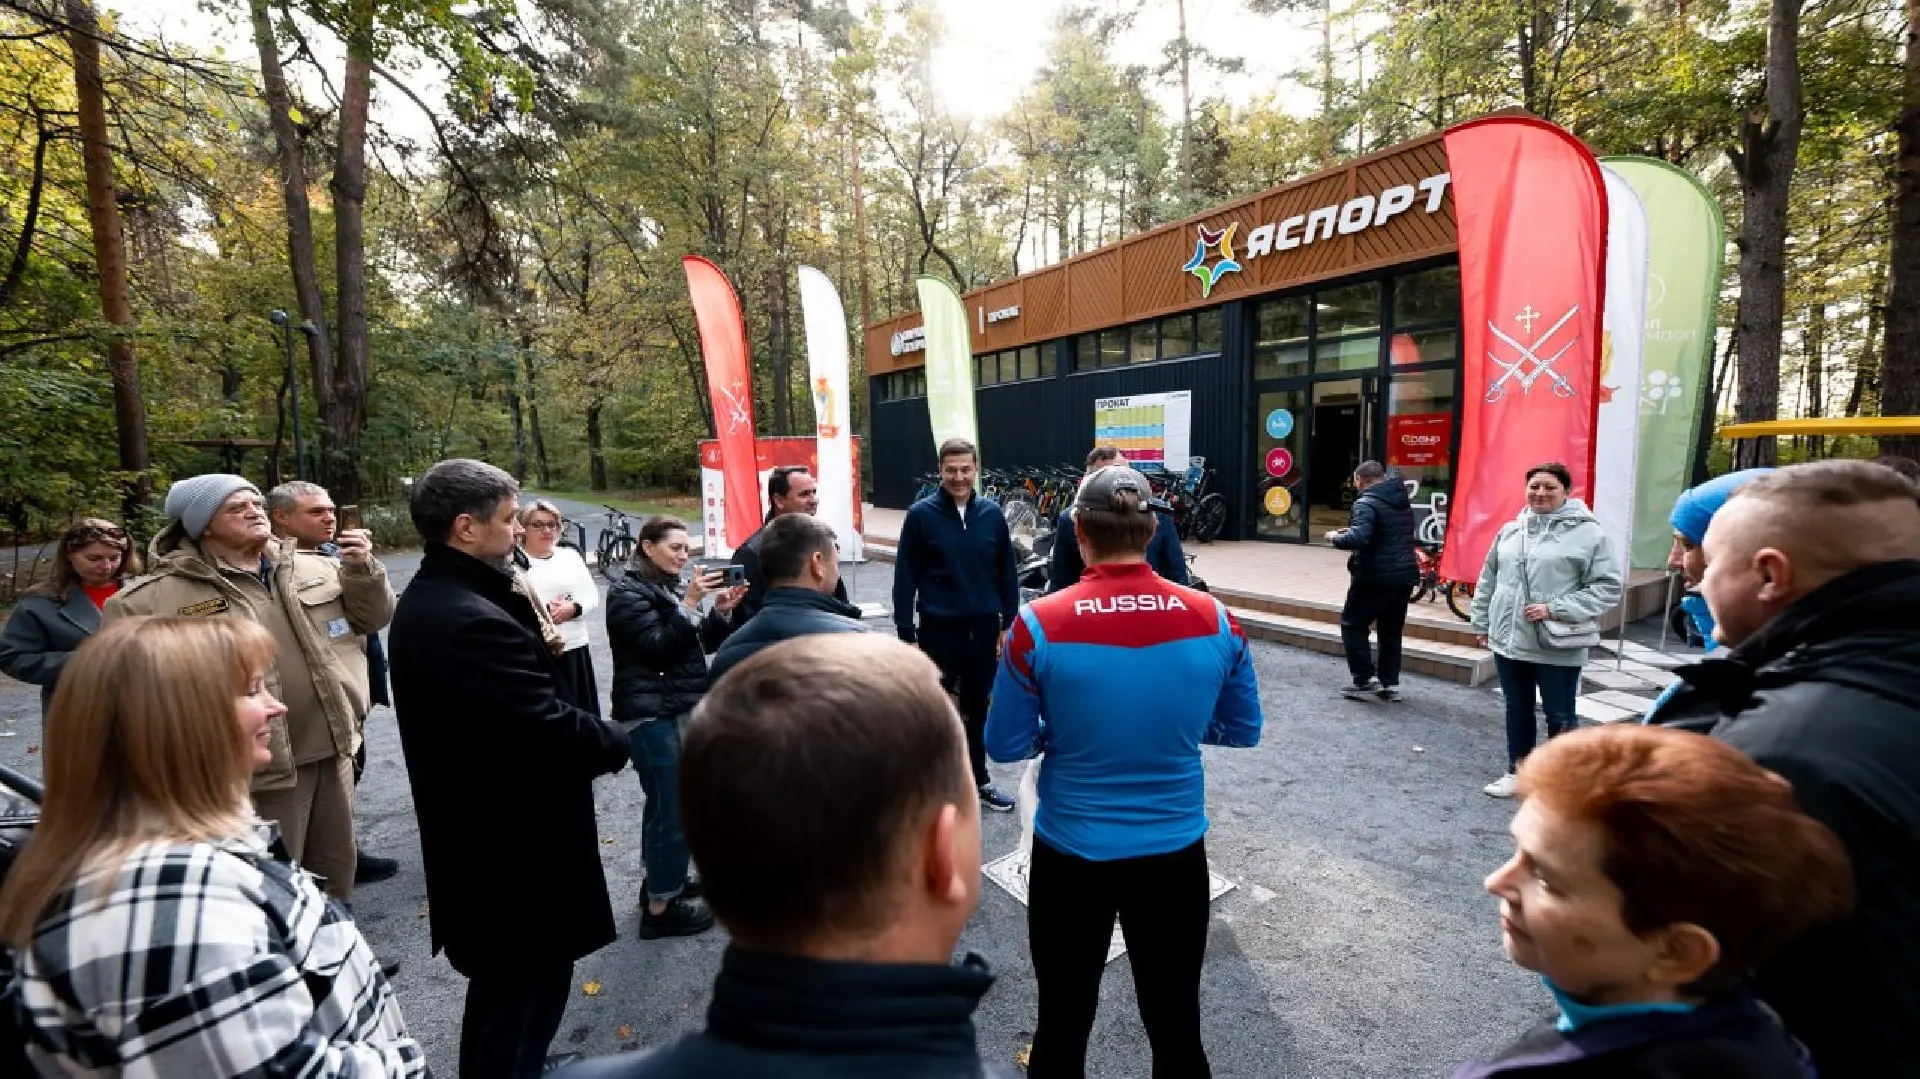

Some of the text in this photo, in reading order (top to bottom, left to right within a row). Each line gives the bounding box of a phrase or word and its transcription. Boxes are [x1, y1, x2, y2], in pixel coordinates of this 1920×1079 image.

[1246, 172, 1451, 259] ЯСПОРТ
[1097, 398, 1130, 409] ПРОКАТ
[1074, 594, 1188, 616] RUSSIA
